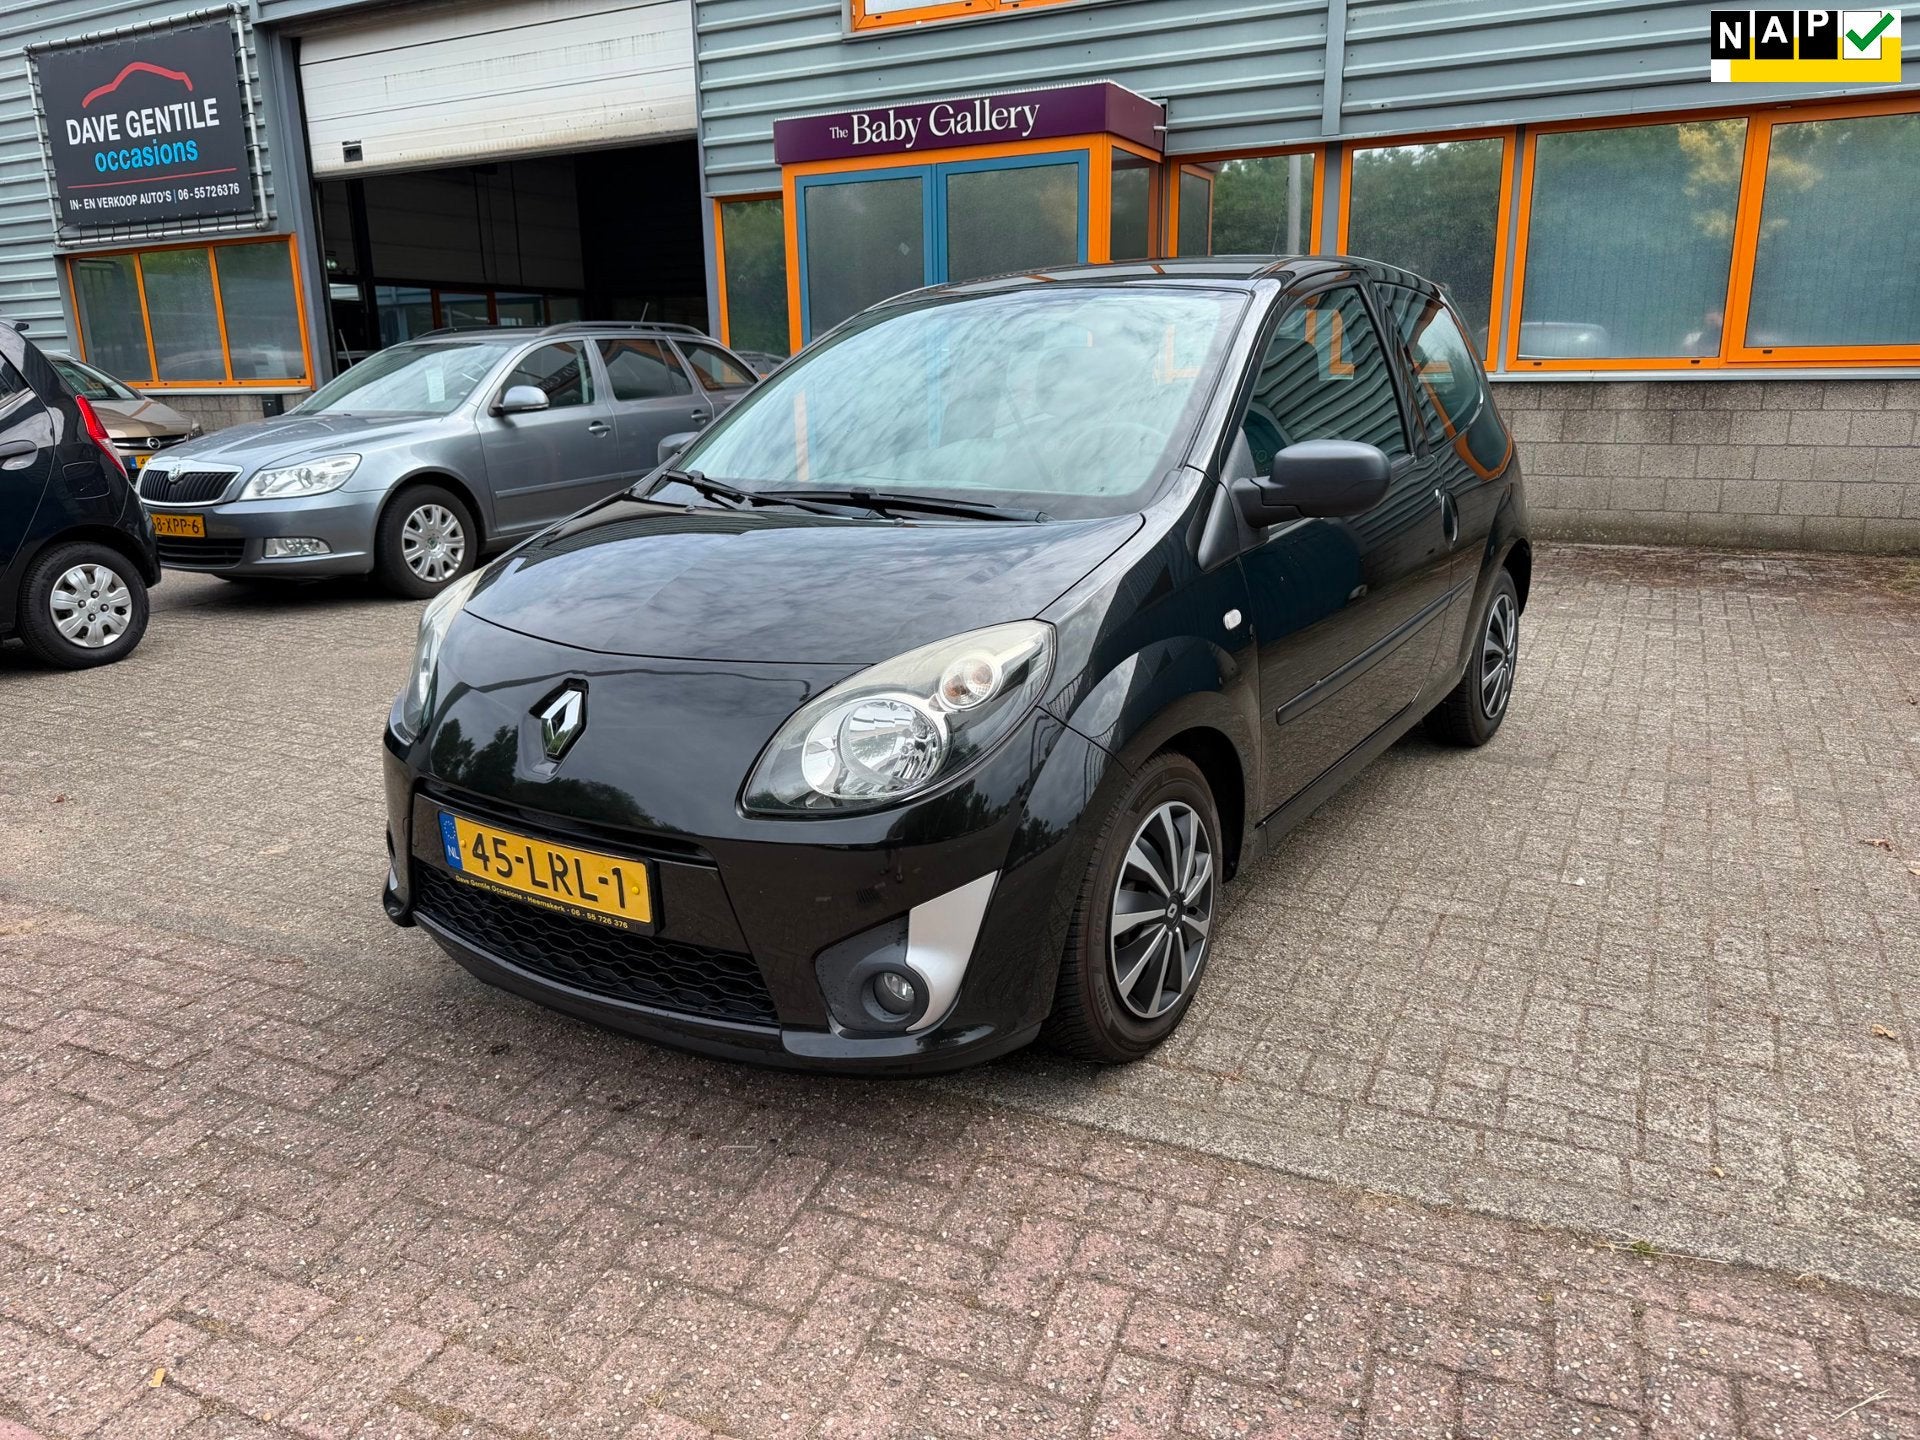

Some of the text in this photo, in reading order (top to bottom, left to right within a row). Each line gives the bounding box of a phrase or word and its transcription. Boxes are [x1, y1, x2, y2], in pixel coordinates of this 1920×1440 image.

[66, 98, 220, 146] DAVE GENTILE
[829, 98, 1040, 149] The Baby Gallery
[94, 138, 199, 173] occasions
[69, 199, 82, 211] IN-
[84, 198, 96, 210] EN
[97, 195, 138, 208] VERKOOP
[140, 190, 172, 205] AUTO'S
[447, 844, 460, 860] NL
[455, 875, 470, 885] Dave
[491, 885, 523, 900] Occasions
[472, 832, 627, 909] 45-LRL-1
